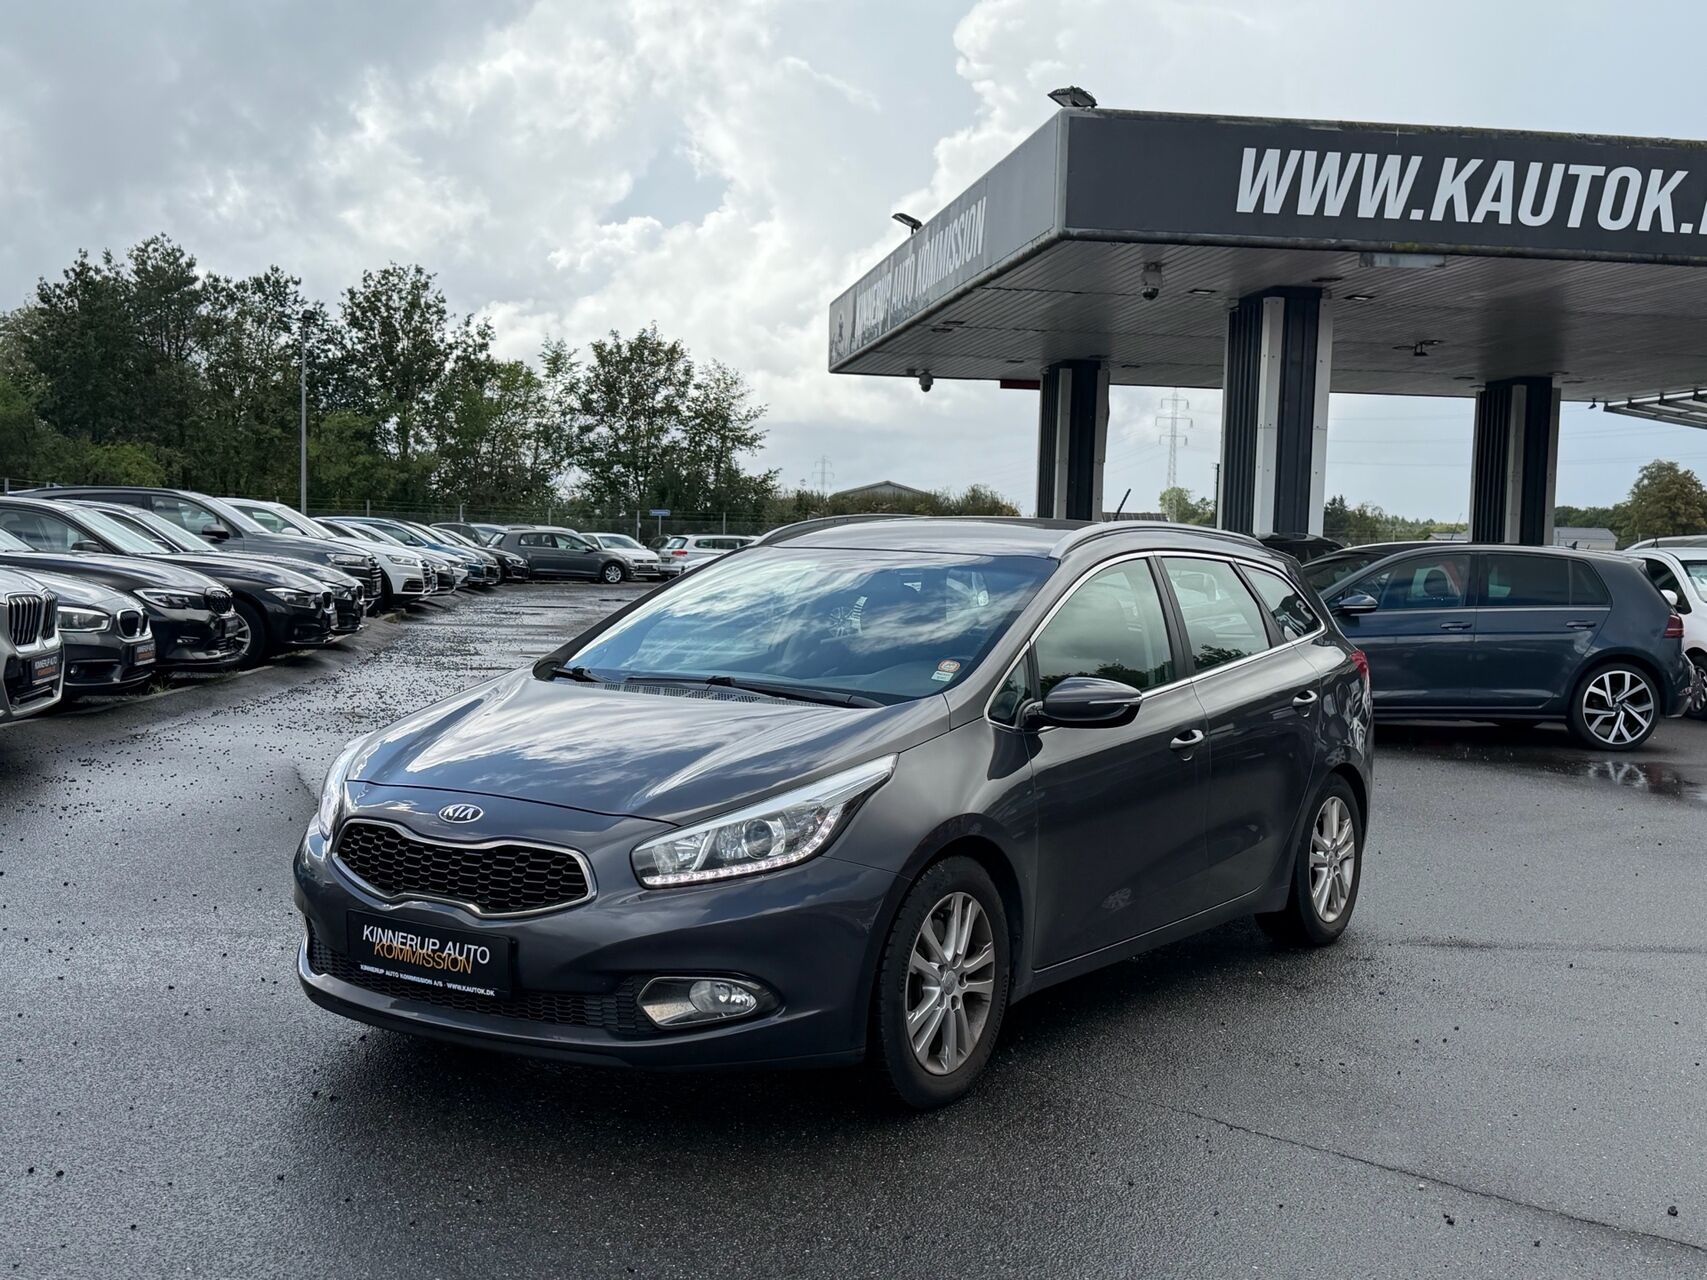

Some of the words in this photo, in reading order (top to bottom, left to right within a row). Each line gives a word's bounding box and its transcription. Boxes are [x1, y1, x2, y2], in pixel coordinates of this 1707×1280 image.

[891, 252, 916, 314] AUTO
[915, 196, 987, 298] KOMMISSION
[443, 804, 476, 820] KIA
[362, 924, 440, 955] KINNERUP
[442, 941, 490, 965] AUTO
[373, 940, 473, 975] KOMMISSION
[385, 969, 400, 978] AUTO
[446, 982, 496, 997] WWW.KAUTOK.DK
